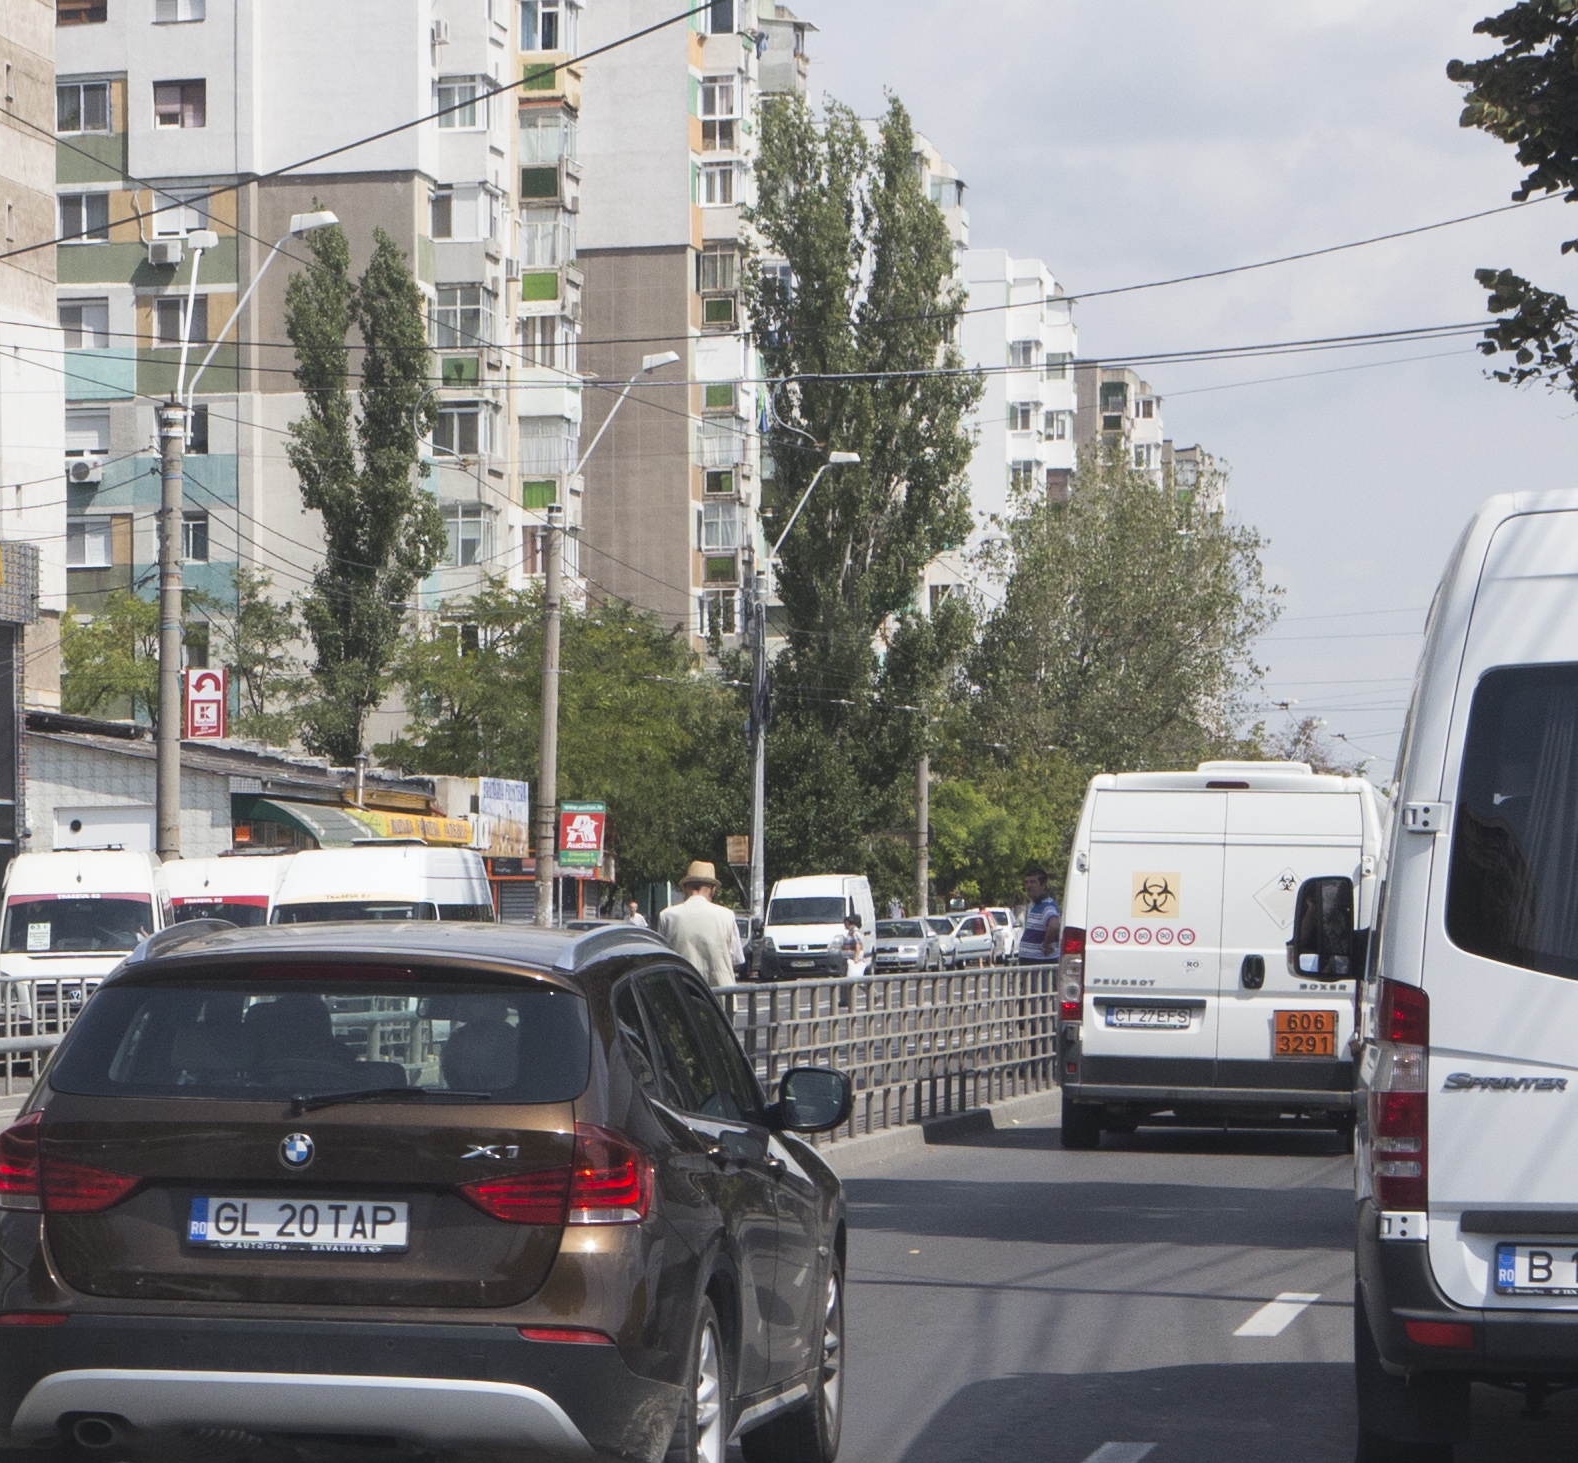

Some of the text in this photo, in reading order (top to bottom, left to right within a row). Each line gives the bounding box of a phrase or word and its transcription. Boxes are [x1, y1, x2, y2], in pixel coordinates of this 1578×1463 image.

[566, 841, 598, 849] Auchan
[1094, 931, 1104, 939] 50
[1116, 931, 1127, 939] 70
[1137, 932, 1148, 940] 80
[1159, 932, 1170, 940] 90
[1181, 933, 1192, 941] 100
[1093, 978, 1156, 987] PEUGEOT
[1299, 983, 1347, 991] BOXER
[1115, 1008, 1134, 1022] CT
[1287, 1013, 1325, 1031] 606
[1279, 1035, 1329, 1053] 3291
[460, 1144, 519, 1159] X1
[214, 1202, 397, 1239] GL 20 TAP
[190, 1221, 207, 1235] RO
[1528, 1250, 1554, 1283] B
[1498, 1269, 1515, 1282] RO
